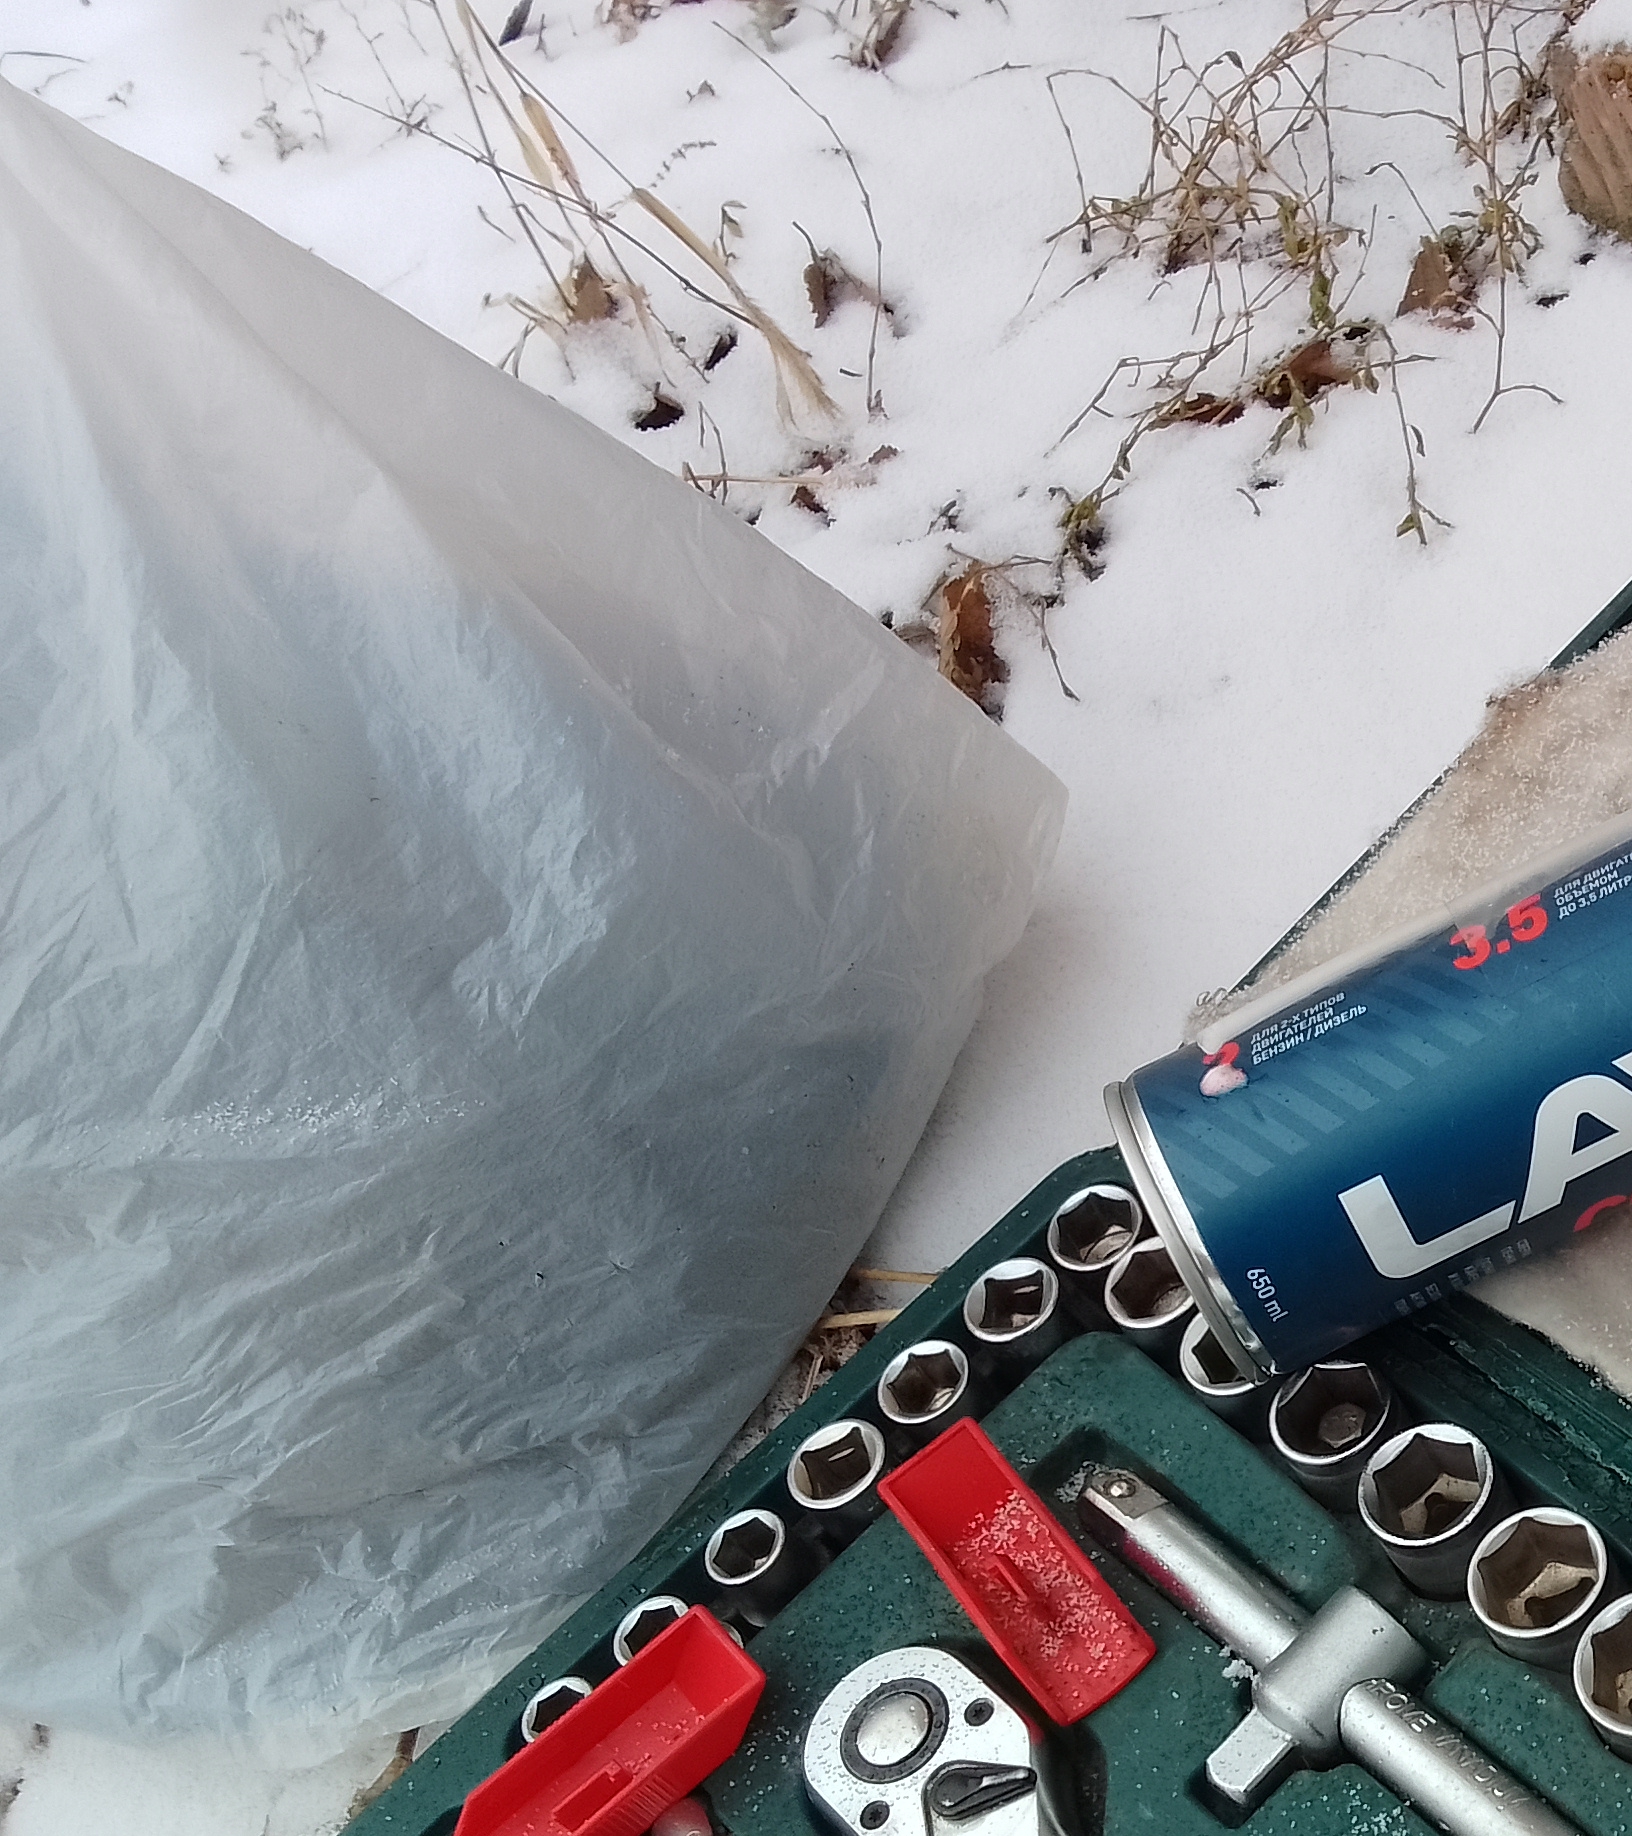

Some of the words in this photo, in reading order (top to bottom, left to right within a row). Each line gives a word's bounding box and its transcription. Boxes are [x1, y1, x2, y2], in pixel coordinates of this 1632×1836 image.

[1553, 878, 1582, 899] ДЛЯ
[1555, 870, 1619, 906] ОБЪЕМОМ
[1558, 903, 1577, 920] ДО
[1579, 891, 1598, 912] 3,5
[1449, 893, 1549, 971] 3.5
[1250, 1023, 1279, 1045] ДЛЯ
[1301, 992, 1346, 1018] ТИПОВ
[1250, 1006, 1335, 1056] ДВИГАТЕЛЕЙ
[1252, 1035, 1305, 1066] БЕНЗИН
[1313, 1004, 1368, 1039] ДИЗЕЛЬ
[1246, 1268, 1276, 1299] 650
[1264, 1299, 1289, 1322] ml
